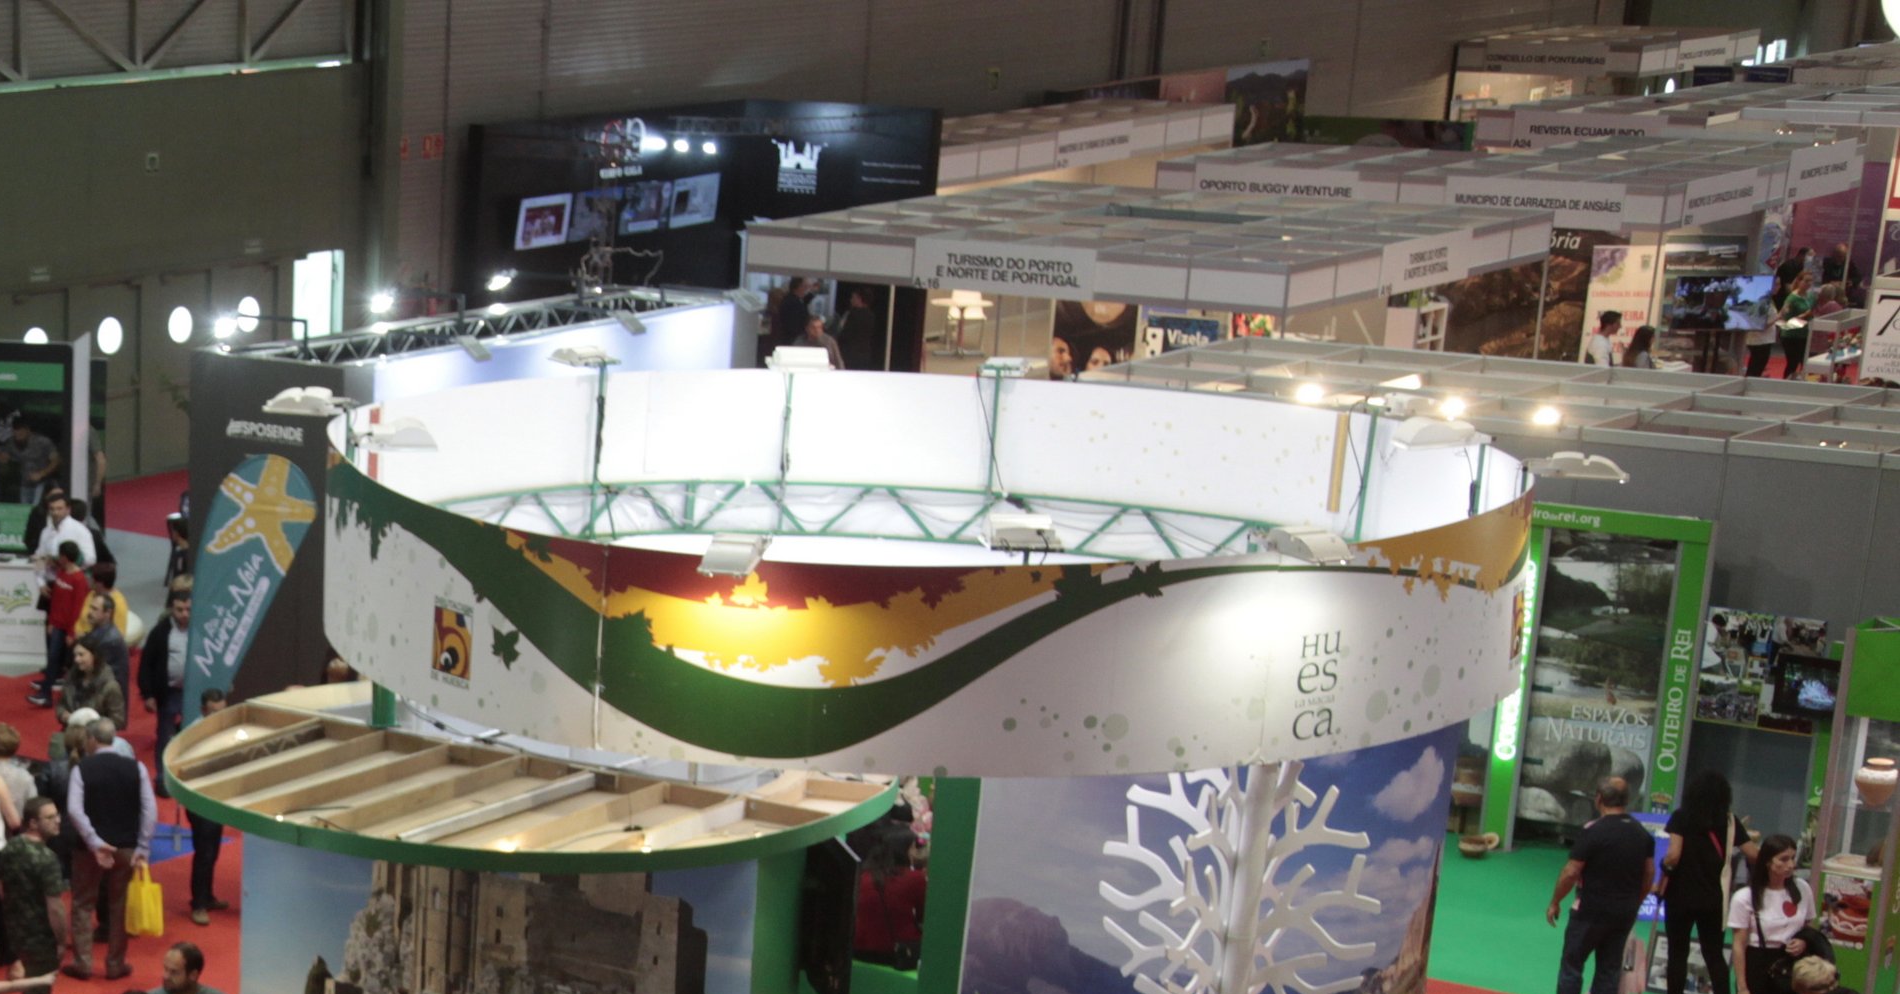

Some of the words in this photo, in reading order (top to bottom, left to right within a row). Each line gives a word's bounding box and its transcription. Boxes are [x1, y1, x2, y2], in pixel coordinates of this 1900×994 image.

[1532, 55, 1546, 63] DE
[1530, 125, 1573, 136] REVISTA
[1513, 139, 1531, 148] A24
[1200, 179, 1247, 193] OPORTO
[1249, 182, 1289, 195] BUGGY
[1291, 184, 1352, 198] AVENTURE
[1455, 193, 1498, 206] MUNICIPIO
[1500, 196, 1513, 206] DE
[1513, 196, 1567, 209] CARRAZEDA
[1569, 199, 1581, 210] DE
[1551, 230, 1581, 249] ória
[947, 252, 1003, 269] TURISMO
[1006, 258, 1025, 271] DO
[1028, 260, 1073, 274] PORTO
[936, 265, 944, 277] E
[947, 266, 988, 281] NORTE
[991, 270, 1010, 282] DE
[1012, 272, 1080, 288] PORTUGAL
[194, 553, 264, 678] Muros-Noia
[1301, 630, 1342, 659] HU
[1670, 628, 1693, 662] REI
[1297, 659, 1338, 694] es
[1674, 663, 1688, 684] DE
[1571, 705, 1649, 730] ESPAZOS
[1544, 716, 1647, 751] NATURAIS
[1656, 686, 1684, 773] OUTEIRO
